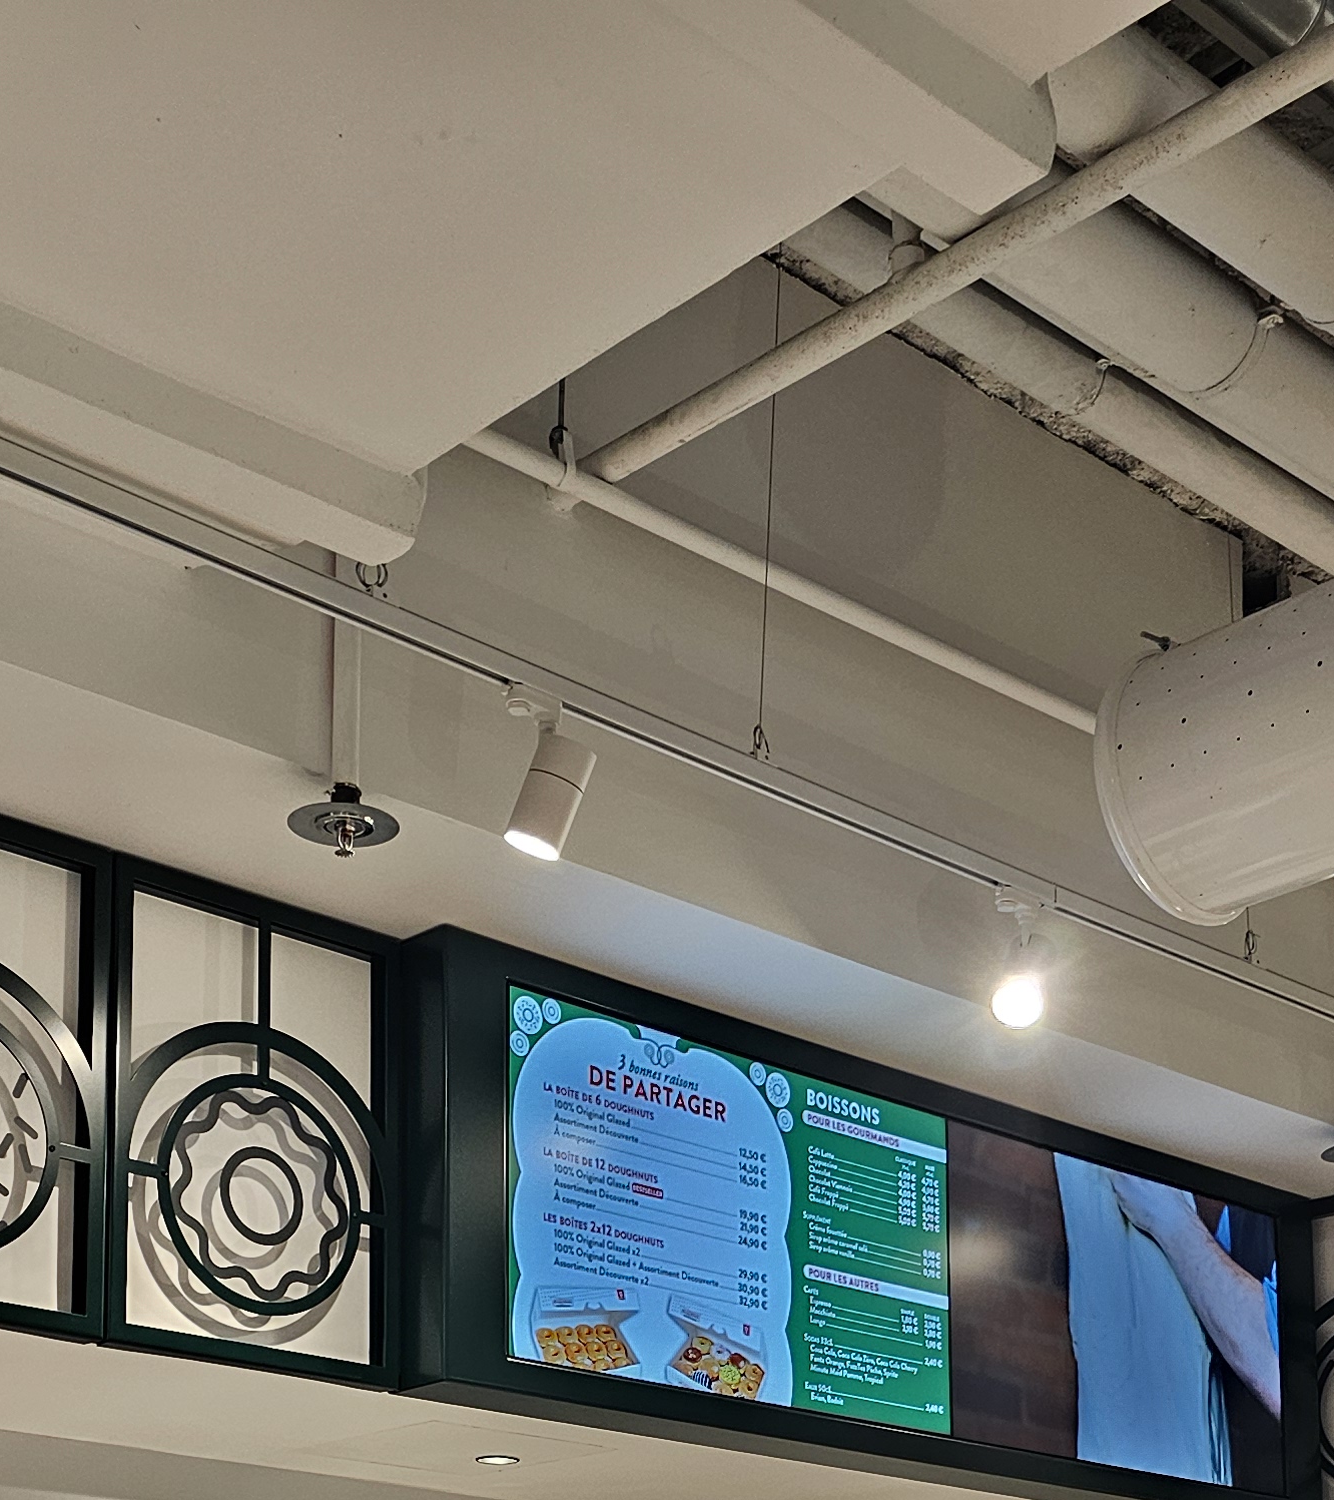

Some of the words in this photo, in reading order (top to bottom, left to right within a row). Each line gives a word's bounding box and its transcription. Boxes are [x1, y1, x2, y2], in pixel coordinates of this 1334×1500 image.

[618, 1054, 625, 1070] 3
[629, 1063, 661, 1080] bonnes
[664, 1073, 699, 1091] raisons
[544, 1082, 552, 1092] LA
[556, 1085, 579, 1099] BOÎTE
[582, 1092, 592, 1103] DE
[596, 1094, 601, 1105] 6
[604, 1099, 654, 1120] DOUGHNUTS
[589, 1065, 616, 1091] DE
[623, 1075, 727, 1122] PARTAGER
[807, 1089, 880, 1124] BOISSONS
[554, 1099, 574, 1112] 100%
[576, 1105, 605, 1120] Original
[607, 1113, 630, 1127] Glazed
[739, 1148, 758, 1161] 12,50
[760, 1154, 766, 1163] €
[554, 1113, 597, 1132] Assortiment
[599, 1125, 638, 1143] Découverte
[739, 1162, 758, 1175] 14,50
[761, 1167, 766, 1177] €
[808, 1113, 830, 1128] POUR
[832, 1121, 845, 1132] LES
[847, 1124, 899, 1147] GOURMANDS
[544, 1147, 552, 1157] LA
[556, 1150, 579, 1163] BOÎTE
[582, 1157, 592, 1167] DE
[595, 1158, 605, 1170] 12
[608, 1164, 658, 1183] DOUGHNUTS
[554, 1124, 560, 1135] À
[562, 1132, 596, 1145] composer
[739, 1175, 759, 1188] 16,50
[761, 1180, 766, 1189] €
[808, 1146, 820, 1155] Café
[821, 1150, 834, 1159] Latte
[808, 1155, 837, 1169] Cappuccino
[554, 1164, 574, 1177] 100%
[576, 1169, 605, 1184] Original
[607, 1176, 630, 1191] Glazed
[739, 1210, 759, 1223] 19,90
[761, 1215, 767, 1224] €
[554, 1179, 597, 1196] Assortiment
[599, 1189, 638, 1206] Découverte
[740, 1222, 759, 1235] 21,90
[761, 1227, 767, 1236] €
[809, 1184, 820, 1193] Café
[821, 1187, 838, 1199] Frappé
[832, 1199, 848, 1212] Frappé
[543, 1213, 556, 1223] LES
[560, 1216, 587, 1230] BOÎTES
[590, 1221, 612, 1236] 2x12
[614, 1230, 664, 1248] DOUGHNUTS
[554, 1190, 560, 1201] À
[562, 1197, 596, 1210] composer
[738, 1236, 759, 1248] 24,90
[761, 1241, 767, 1250] €
[809, 1232, 822, 1243] Sirop
[554, 1229, 574, 1241] 100%
[576, 1234, 605, 1249] Original
[607, 1241, 630, 1255] Glazed
[632, 1248, 640, 1256] x2
[739, 1269, 759, 1282] 29,90
[761, 1274, 767, 1283] €
[809, 1241, 822, 1253] Sirop
[554, 1243, 574, 1255] 100%
[576, 1248, 605, 1262] Original
[607, 1255, 630, 1268] Glazed
[639, 1262, 679, 1278] Assortiment
[682, 1271, 718, 1287] Découverte
[738, 1283, 759, 1296] 30,90
[762, 1288, 767, 1297] €
[554, 1257, 597, 1275] Assortiment
[599, 1267, 638, 1284] Découverte
[640, 1277, 649, 1286] x2
[739, 1296, 759, 1309] 32,90
[762, 1301, 767, 1310] €
[809, 1268, 831, 1280] POUR
[834, 1273, 847, 1285] LES
[849, 1276, 879, 1292] AUTRES
[810, 1307, 836, 1318] Macchiato
[810, 1316, 826, 1327] Lungo
[810, 1344, 823, 1354] Coca
[837, 1350, 849, 1359] Coca
[851, 1353, 862, 1362] Cola
[876, 1358, 888, 1367] Coca
[889, 1361, 900, 1369] Cola
[901, 1363, 918, 1375] Cherry
[810, 1354, 824, 1364] Fanta
[884, 1368, 898, 1379] Sprite
[810, 1365, 828, 1374] Minute
[830, 1368, 842, 1376] Maid
[864, 1374, 883, 1385] Tropical
